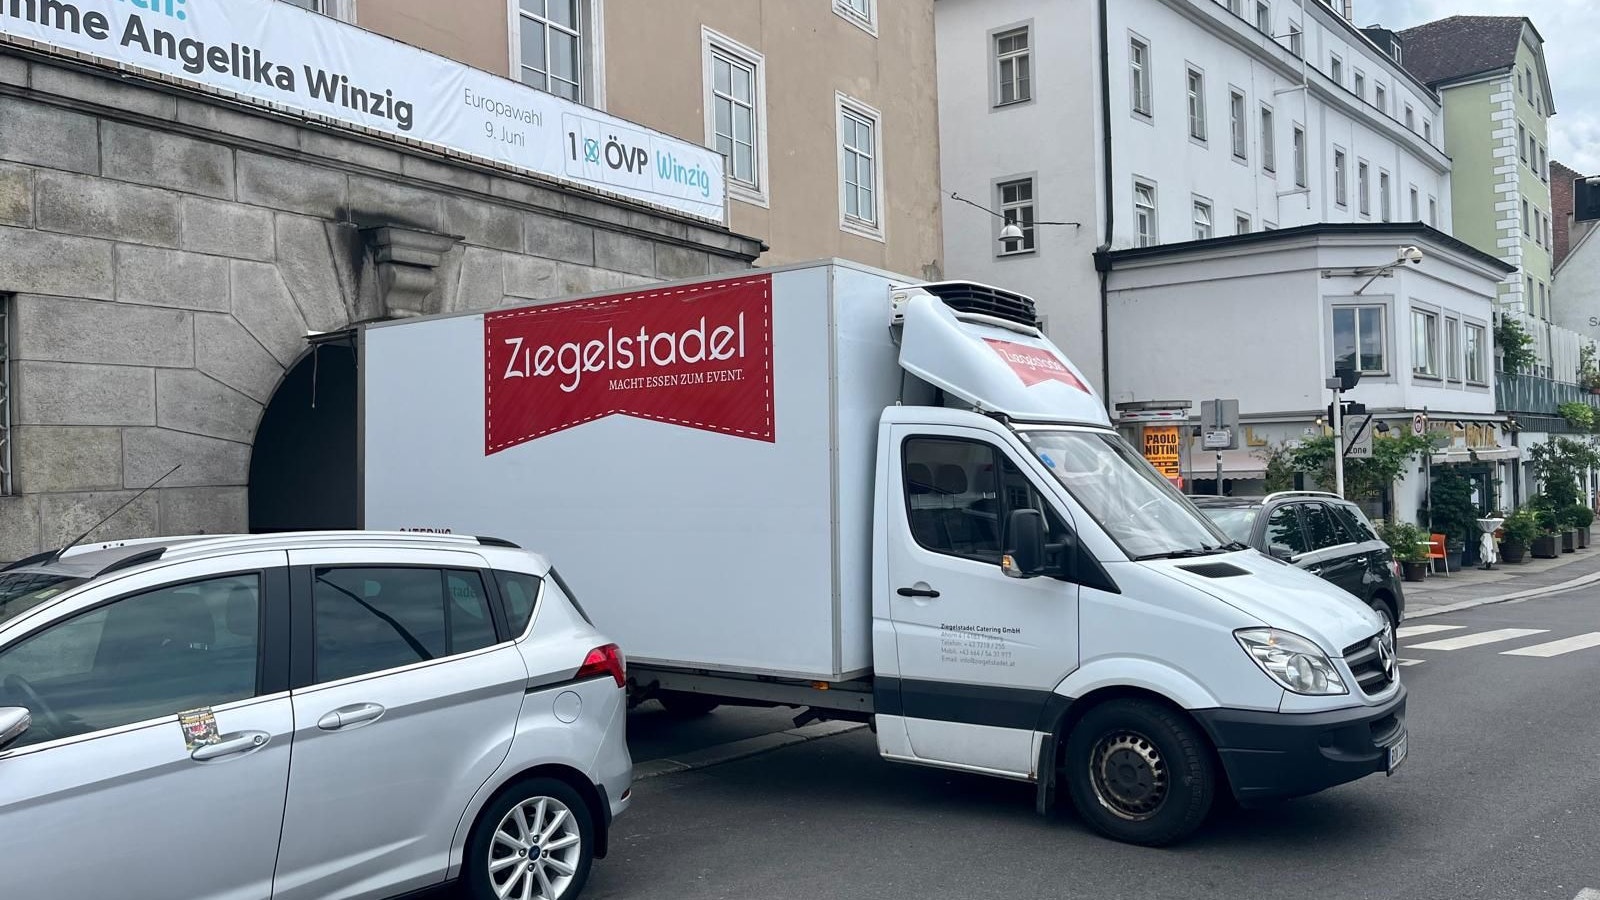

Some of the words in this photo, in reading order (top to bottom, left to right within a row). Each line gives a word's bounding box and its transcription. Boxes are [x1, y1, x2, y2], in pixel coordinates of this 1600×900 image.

[120, 13, 296, 93] Angelika
[303, 64, 414, 131] Winzig
[463, 87, 543, 128] Europawahl
[484, 120, 498, 141] 9.
[500, 124, 526, 148] Juni
[568, 131, 577, 161] 1
[605, 134, 649, 175] ÖVP
[656, 149, 710, 198] Winzig
[503, 311, 745, 393] Ziegelstadel
[608, 377, 645, 391] MACHT
[646, 374, 679, 388] ESSEN
[680, 372, 704, 386] ZUM
[706, 368, 745, 384] EVENT.
[1144, 444, 1178, 456] NUTINI
[1146, 433, 1177, 445] PAOLO
[940, 623, 975, 632] Ziegelstadel
[976, 625, 1001, 635] Catering
[1002, 626, 1021, 634] GmbH
